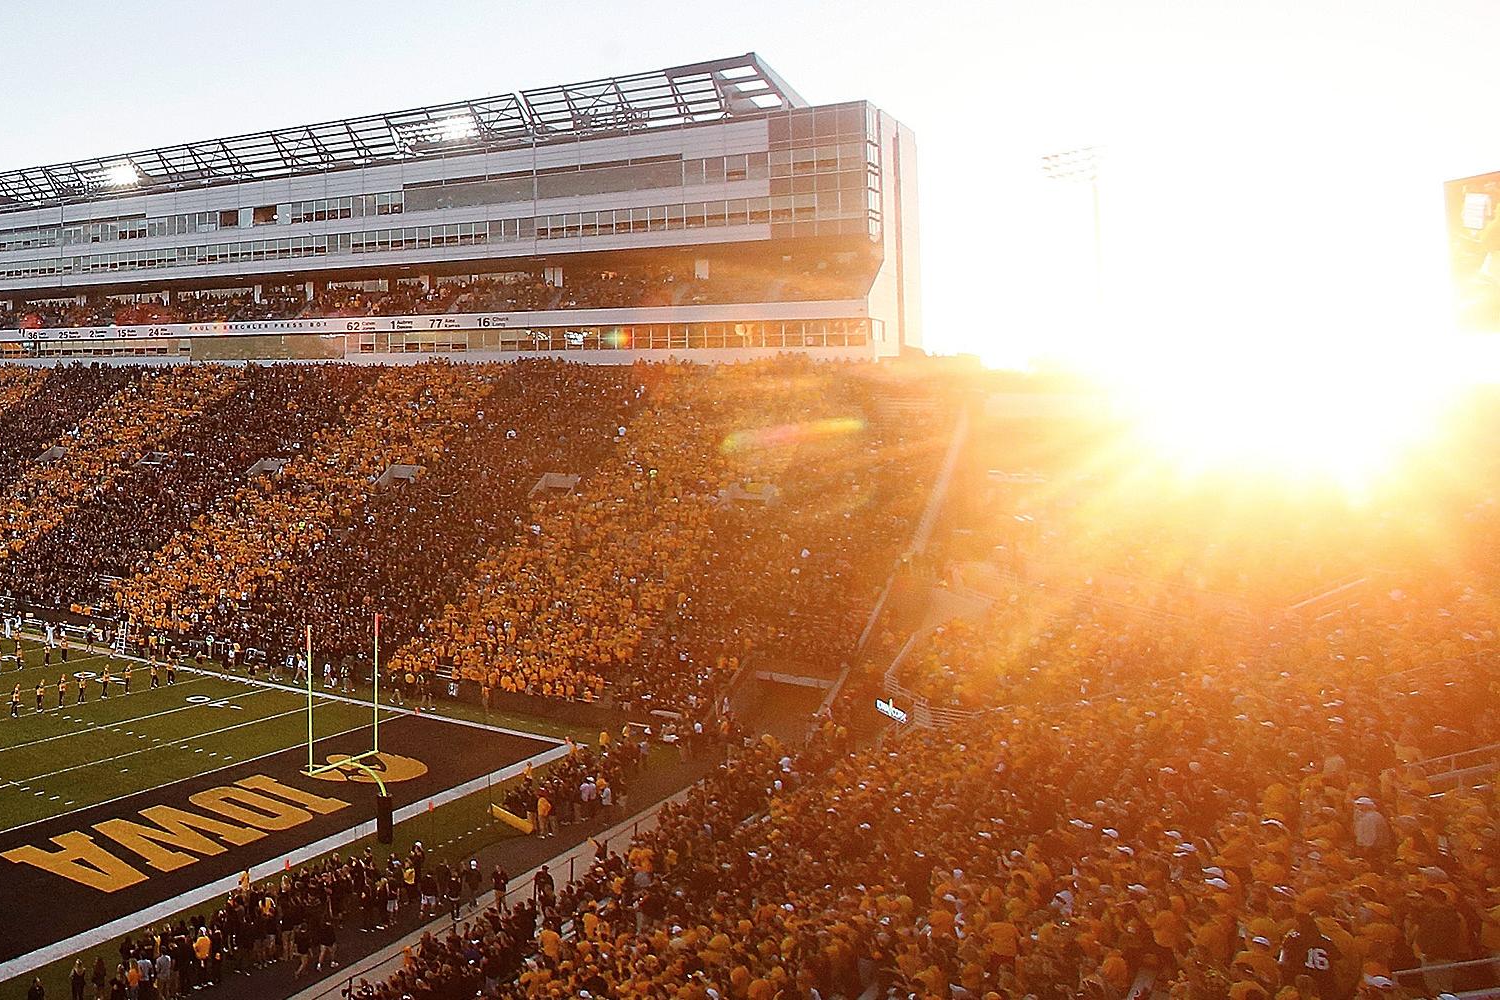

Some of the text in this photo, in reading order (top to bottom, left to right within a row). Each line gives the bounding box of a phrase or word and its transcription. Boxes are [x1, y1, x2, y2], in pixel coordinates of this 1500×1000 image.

[346, 321, 360, 331] 62
[390, 320, 396, 329] 1
[429, 318, 443, 329] 77
[476, 317, 490, 327] 16
[28, 332, 38, 340] 36
[58, 331, 69, 339] 25
[89, 330, 95, 338] 2
[117, 329, 127, 337] 15
[149, 328, 159, 337] 24
[1304, 947, 1330, 970] 16
